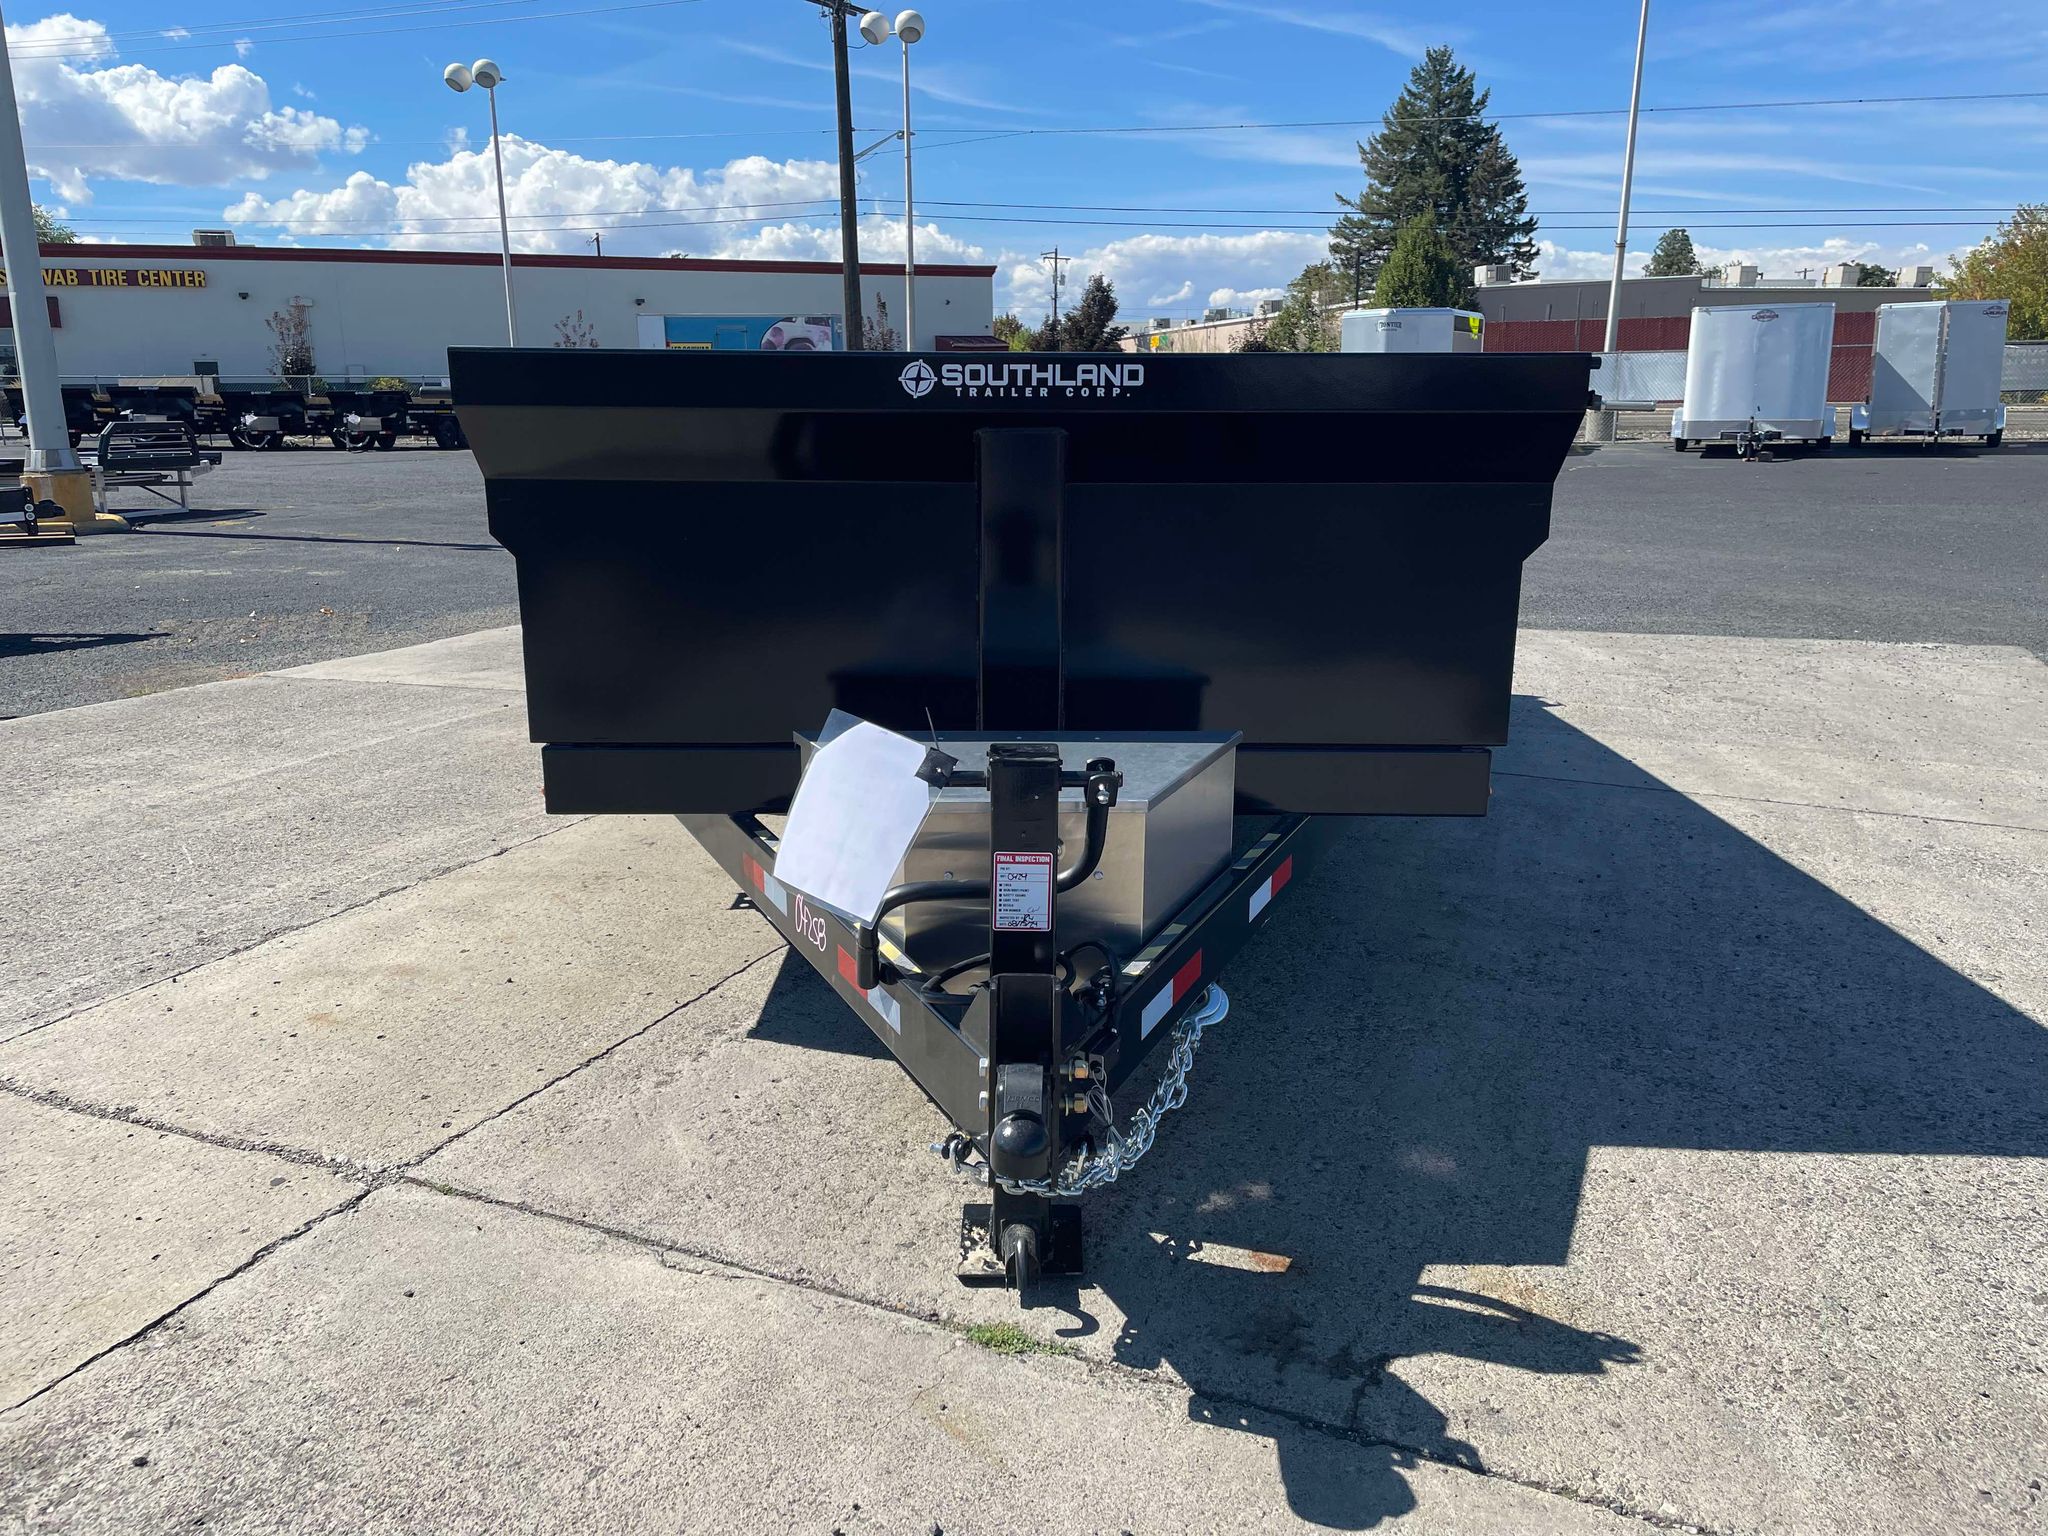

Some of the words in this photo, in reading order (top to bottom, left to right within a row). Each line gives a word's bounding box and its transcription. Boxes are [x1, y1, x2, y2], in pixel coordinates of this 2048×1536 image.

[88, 269, 128, 287] TIRE
[137, 270, 206, 288] CENTER
[941, 364, 1144, 386] SOUTHLAND
[955, 387, 1048, 397] TRAILER
[1065, 387, 1131, 397] CORP.
[1015, 855, 1050, 863] INSPECTION
